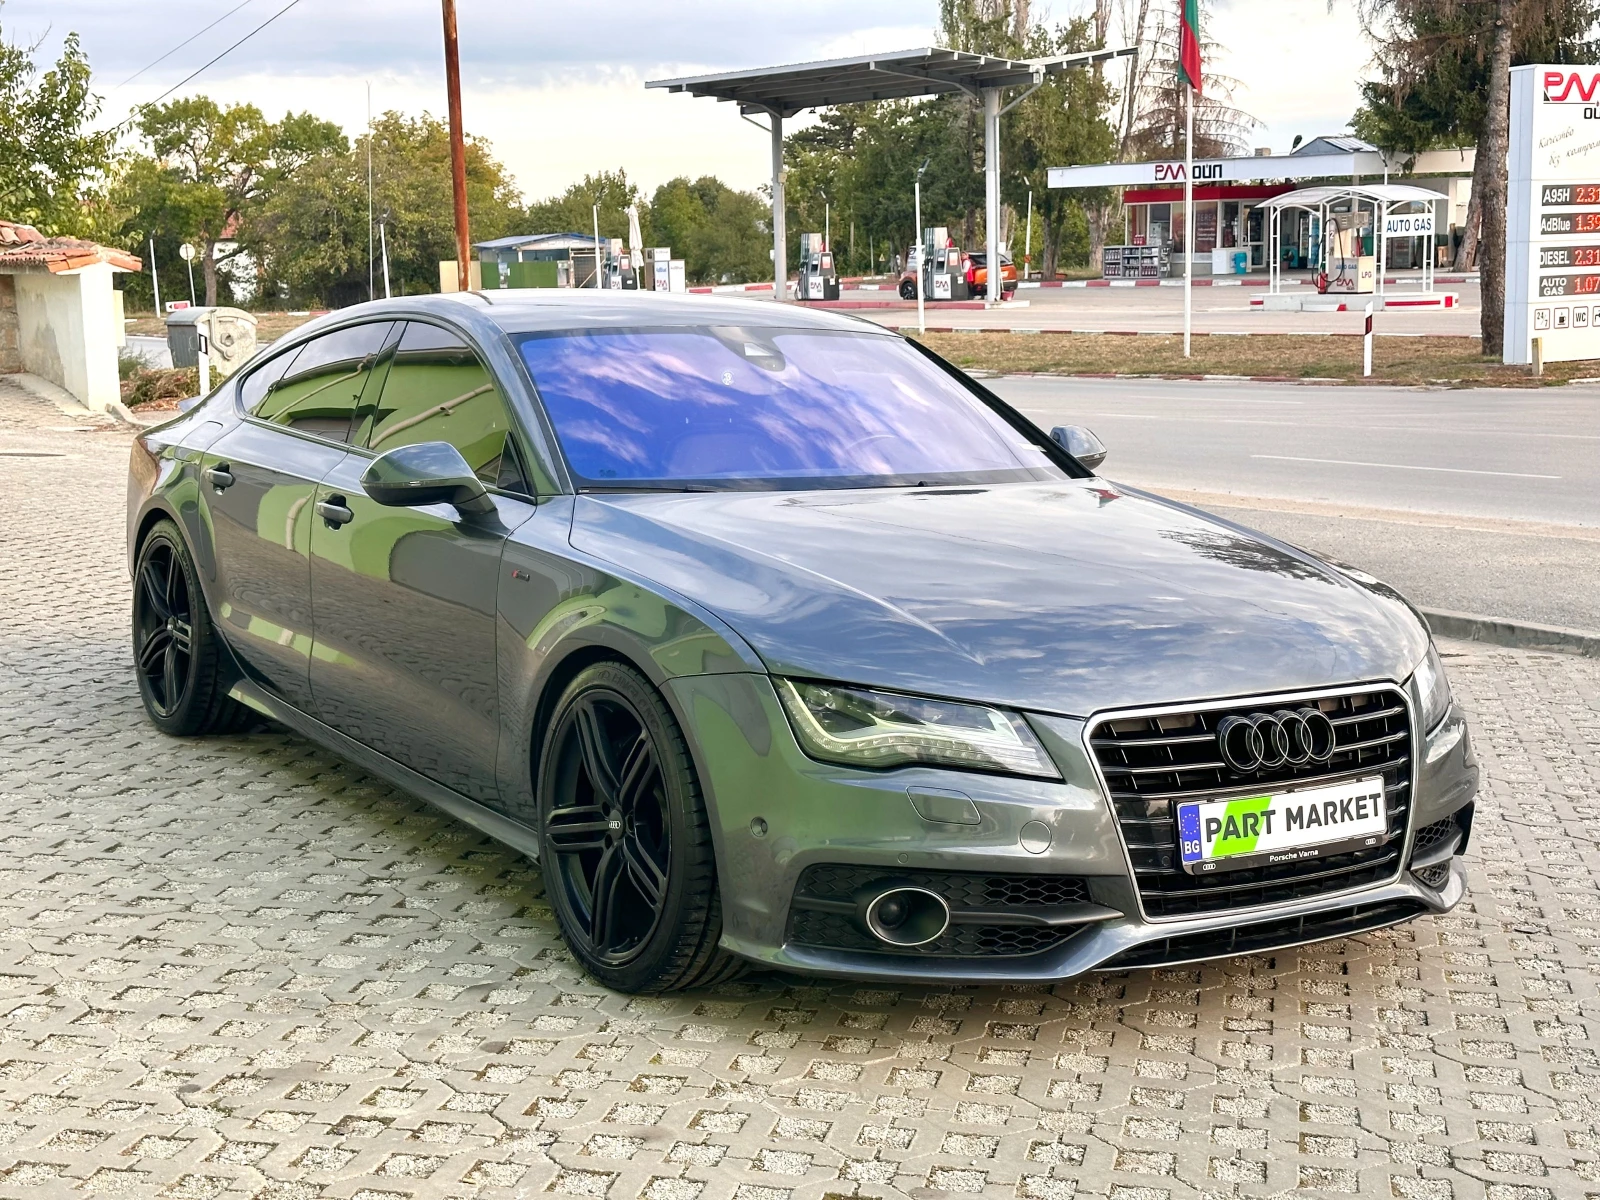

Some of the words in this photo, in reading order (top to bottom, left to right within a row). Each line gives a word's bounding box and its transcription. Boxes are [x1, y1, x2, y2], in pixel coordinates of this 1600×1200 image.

[1387, 219, 1411, 232] AUTO
[1414, 218, 1432, 231] GAS
[1541, 217, 1571, 232] AdBlue
[1540, 250, 1569, 266] DIESEL
[1575, 249, 1600, 265] 2.31
[1361, 271, 1372, 279] LPG
[1541, 277, 1567, 287] AUTO
[1543, 286, 1564, 296] GAS
[1576, 312, 1586, 322] WC
[1205, 809, 1276, 842] PART
[1285, 793, 1381, 831] MARKET
[1184, 839, 1200, 854] BG
[1269, 853, 1297, 862] Porsche
[1299, 850, 1319, 858] Varna
